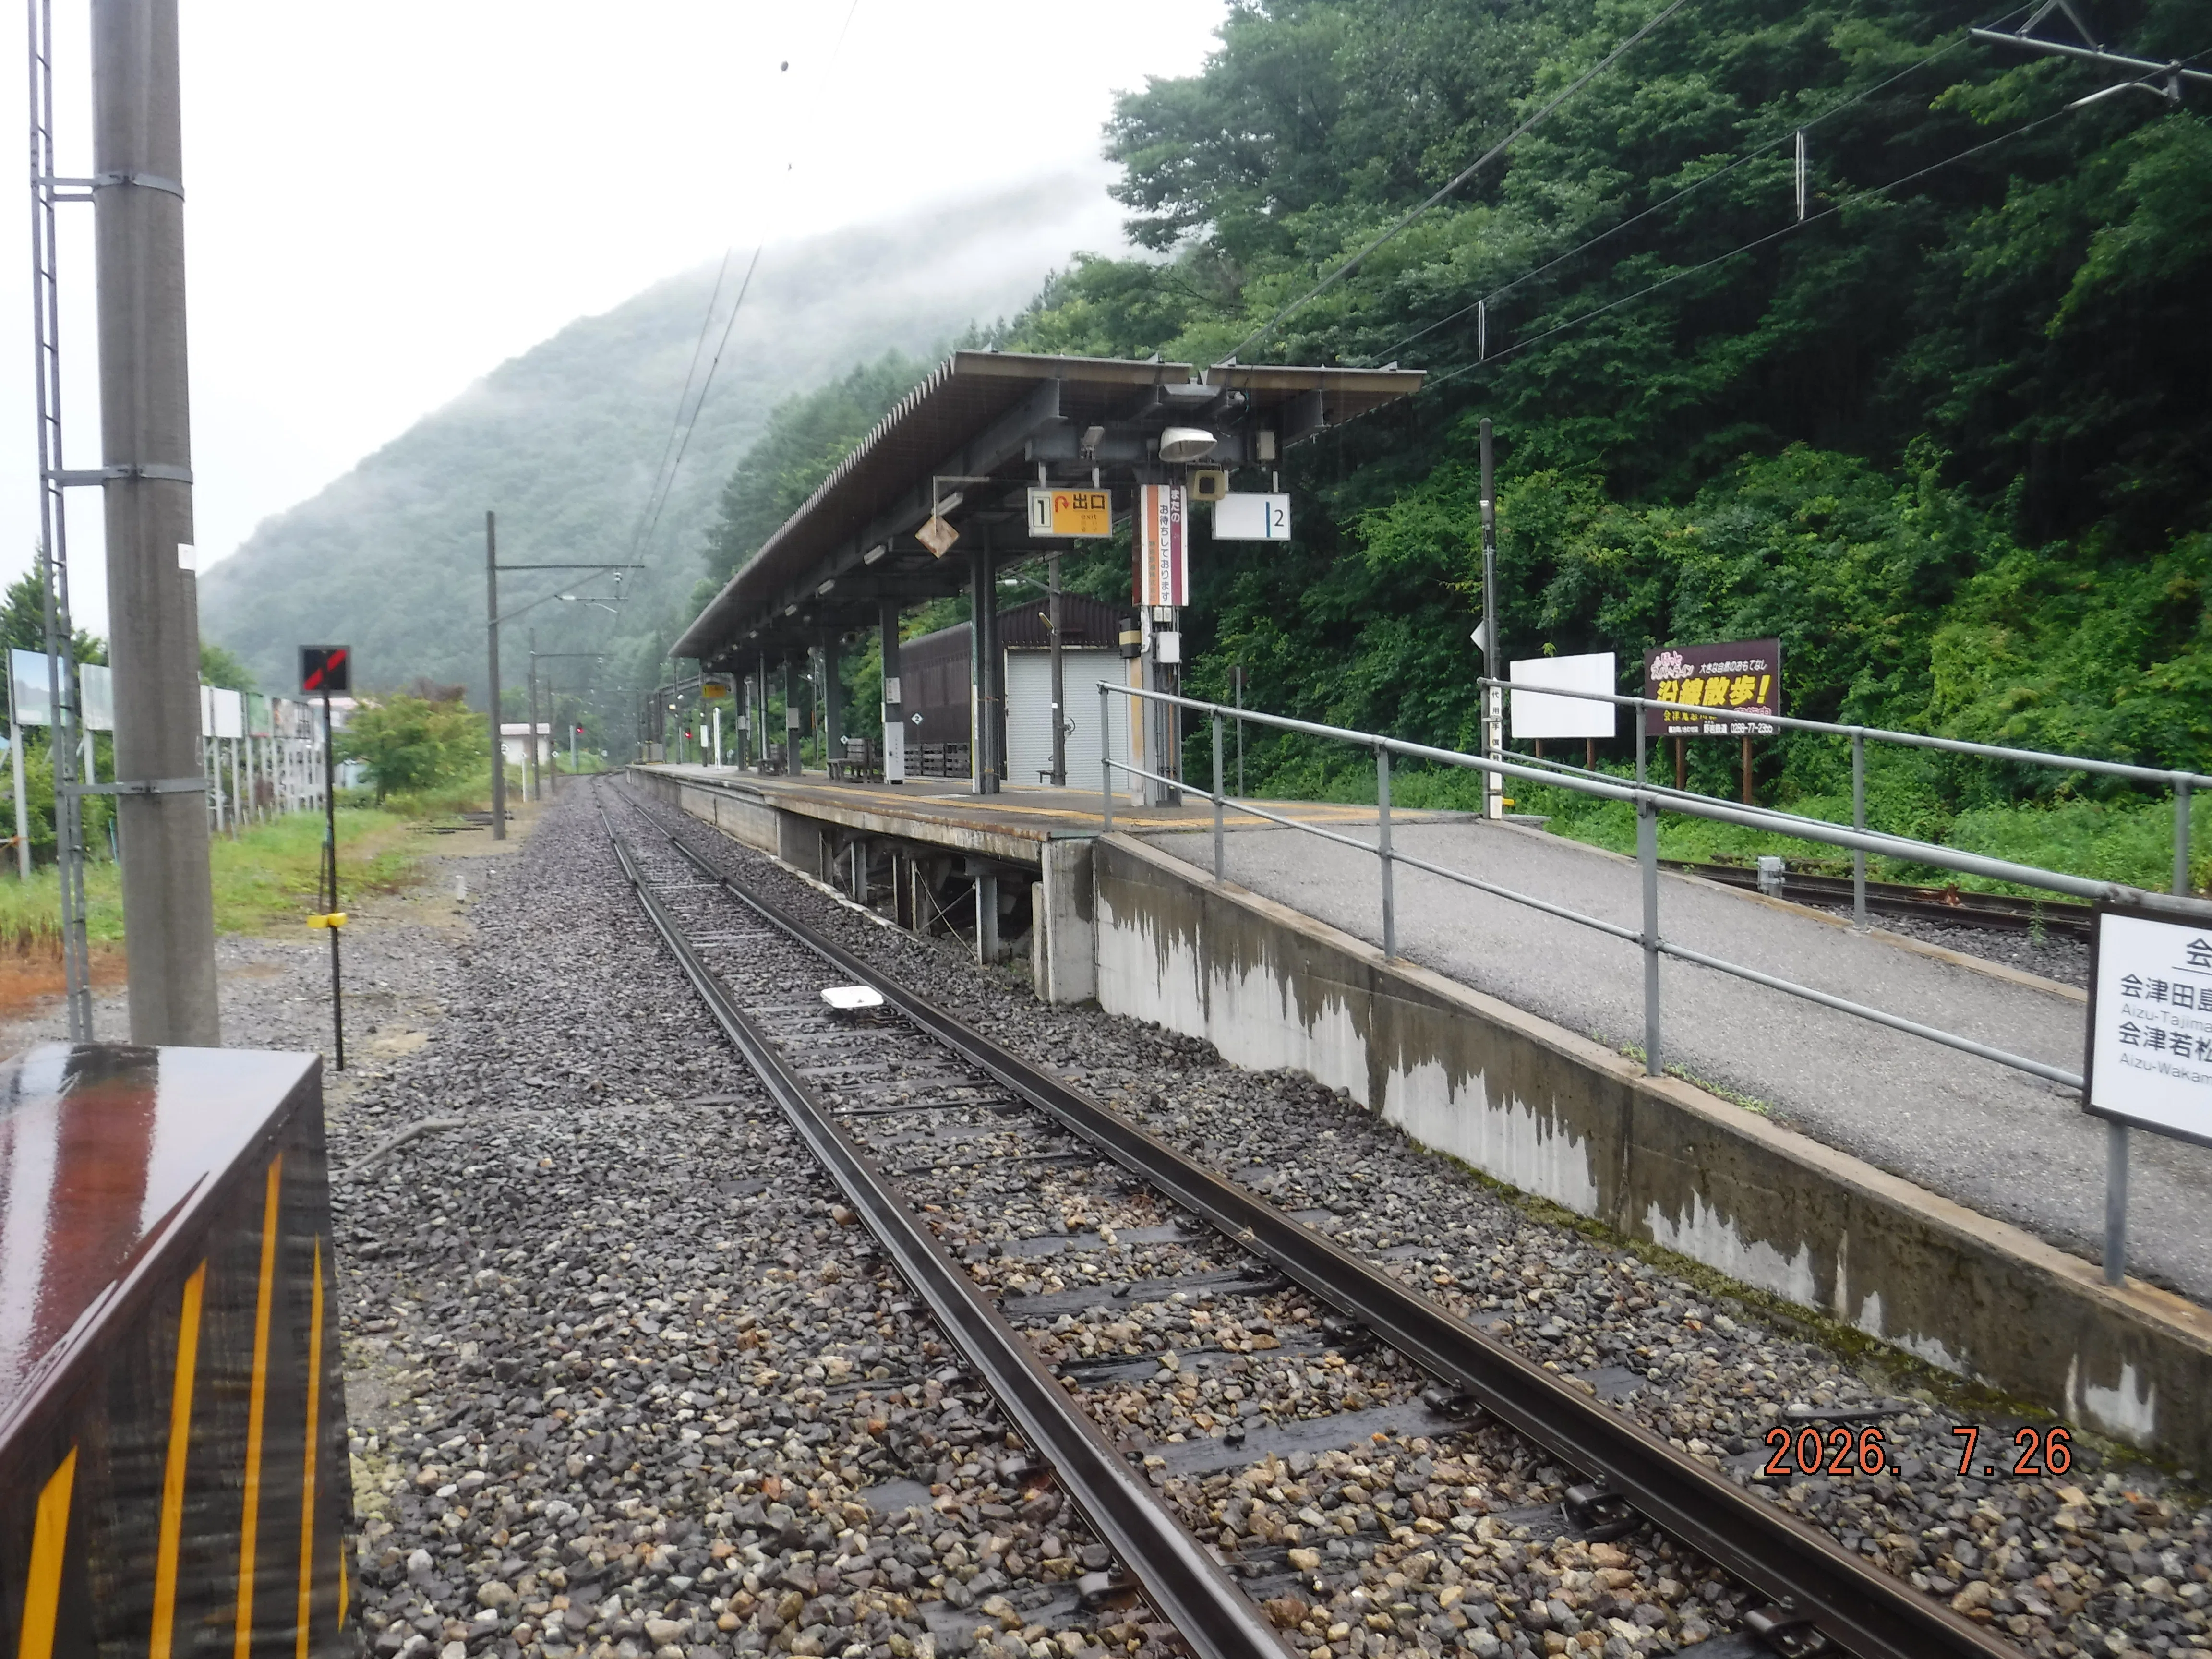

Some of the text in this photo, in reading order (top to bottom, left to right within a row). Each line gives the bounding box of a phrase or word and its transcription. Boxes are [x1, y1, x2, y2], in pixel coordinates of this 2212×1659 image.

[1037, 499, 1045, 525] 1
[1073, 493, 1105, 509] 出口
[1171, 489, 1180, 523] またの
[1274, 509, 1284, 527] 2
[1160, 505, 1169, 601] お待ちしております
[1699, 659, 1767, 674] 大きな自然のおもてなし
[2121, 1003, 2212, 1033] Aizu-Tajima
